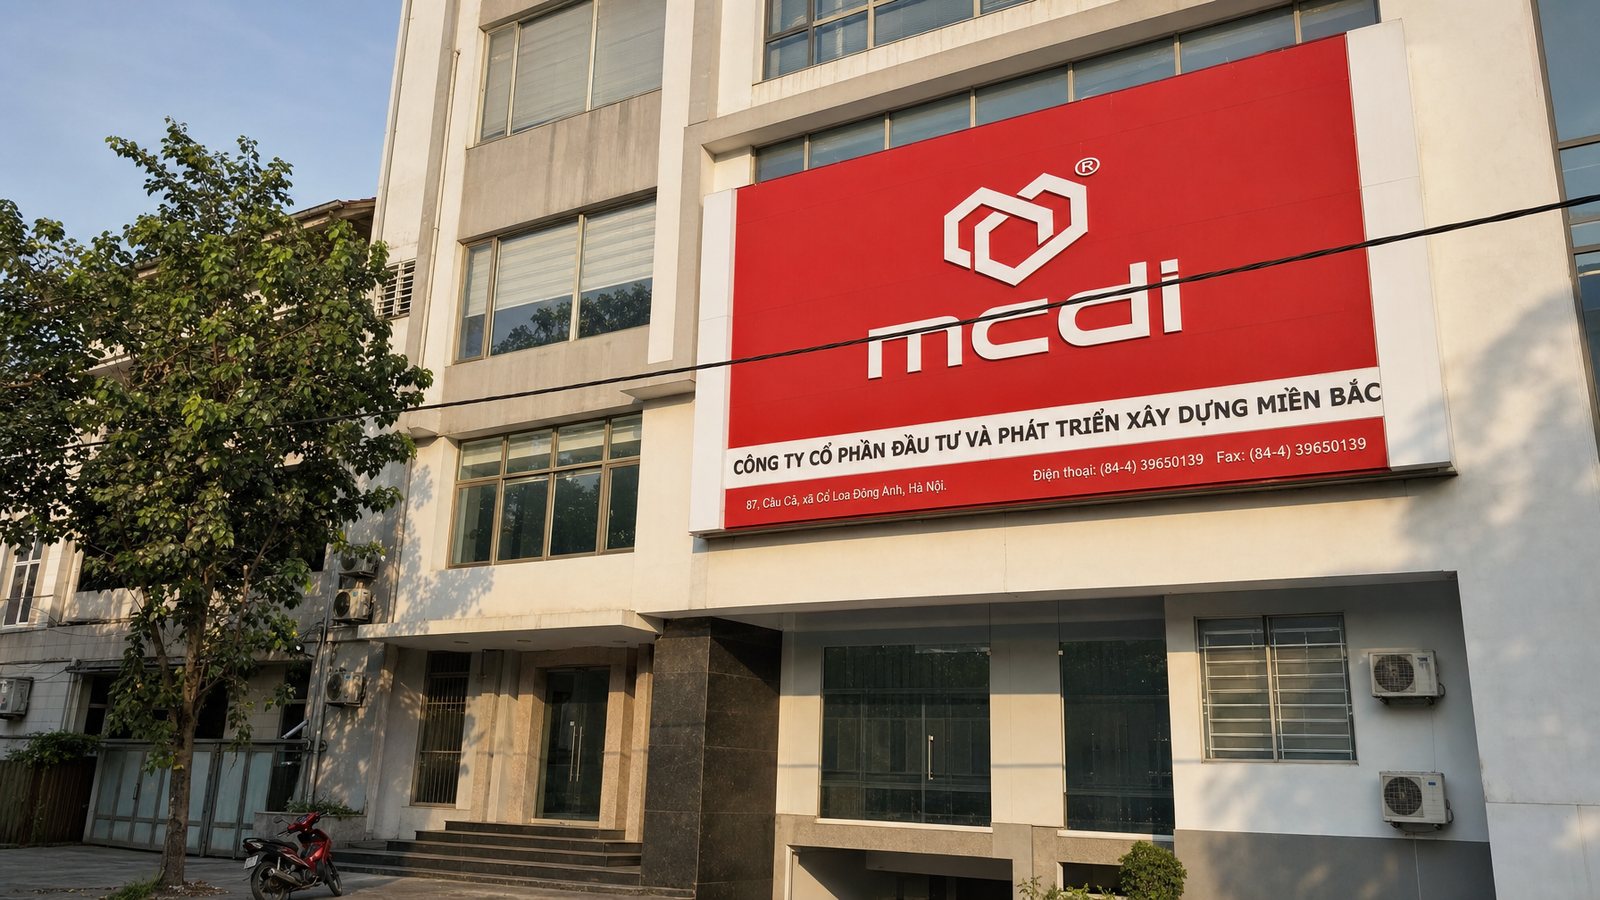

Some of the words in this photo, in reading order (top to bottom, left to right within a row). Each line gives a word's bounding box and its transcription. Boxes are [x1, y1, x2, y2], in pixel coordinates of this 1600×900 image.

[868, 258, 1182, 380] mcdi
[733, 453, 779, 475] CÔNG
[784, 452, 805, 469] TY
[809, 441, 833, 466] CỔ
[838, 439, 886, 463] PHẦN
[891, 433, 930, 456] ĐẦU
[935, 430, 962, 451] TƯ
[965, 425, 992, 447] VÀ
[998, 418, 1050, 444] PHÁT
[1055, 408, 1120, 437] TRIỂN
[1126, 404, 1171, 429] XÂY
[1178, 399, 1249, 426] DỰNG
[1257, 386, 1321, 415] MIỀN
[1330, 378, 1382, 407] BẮC
[1033, 468, 1060, 482] Điện
[1063, 464, 1097, 479] thoại:
[1100, 460, 1137, 477] (84-4)
[1140, 453, 1204, 471] 39650139
[1216, 450, 1246, 464] Fax:
[1249, 444, 1291, 464] (84-4)
[1295, 437, 1367, 457] 39650139
[746, 499, 760, 511] 87,
[802, 493, 814, 505] xã
[832, 490, 851, 502] Loa
[908, 482, 923, 494] Hà
[926, 479, 947, 494] Nội.
